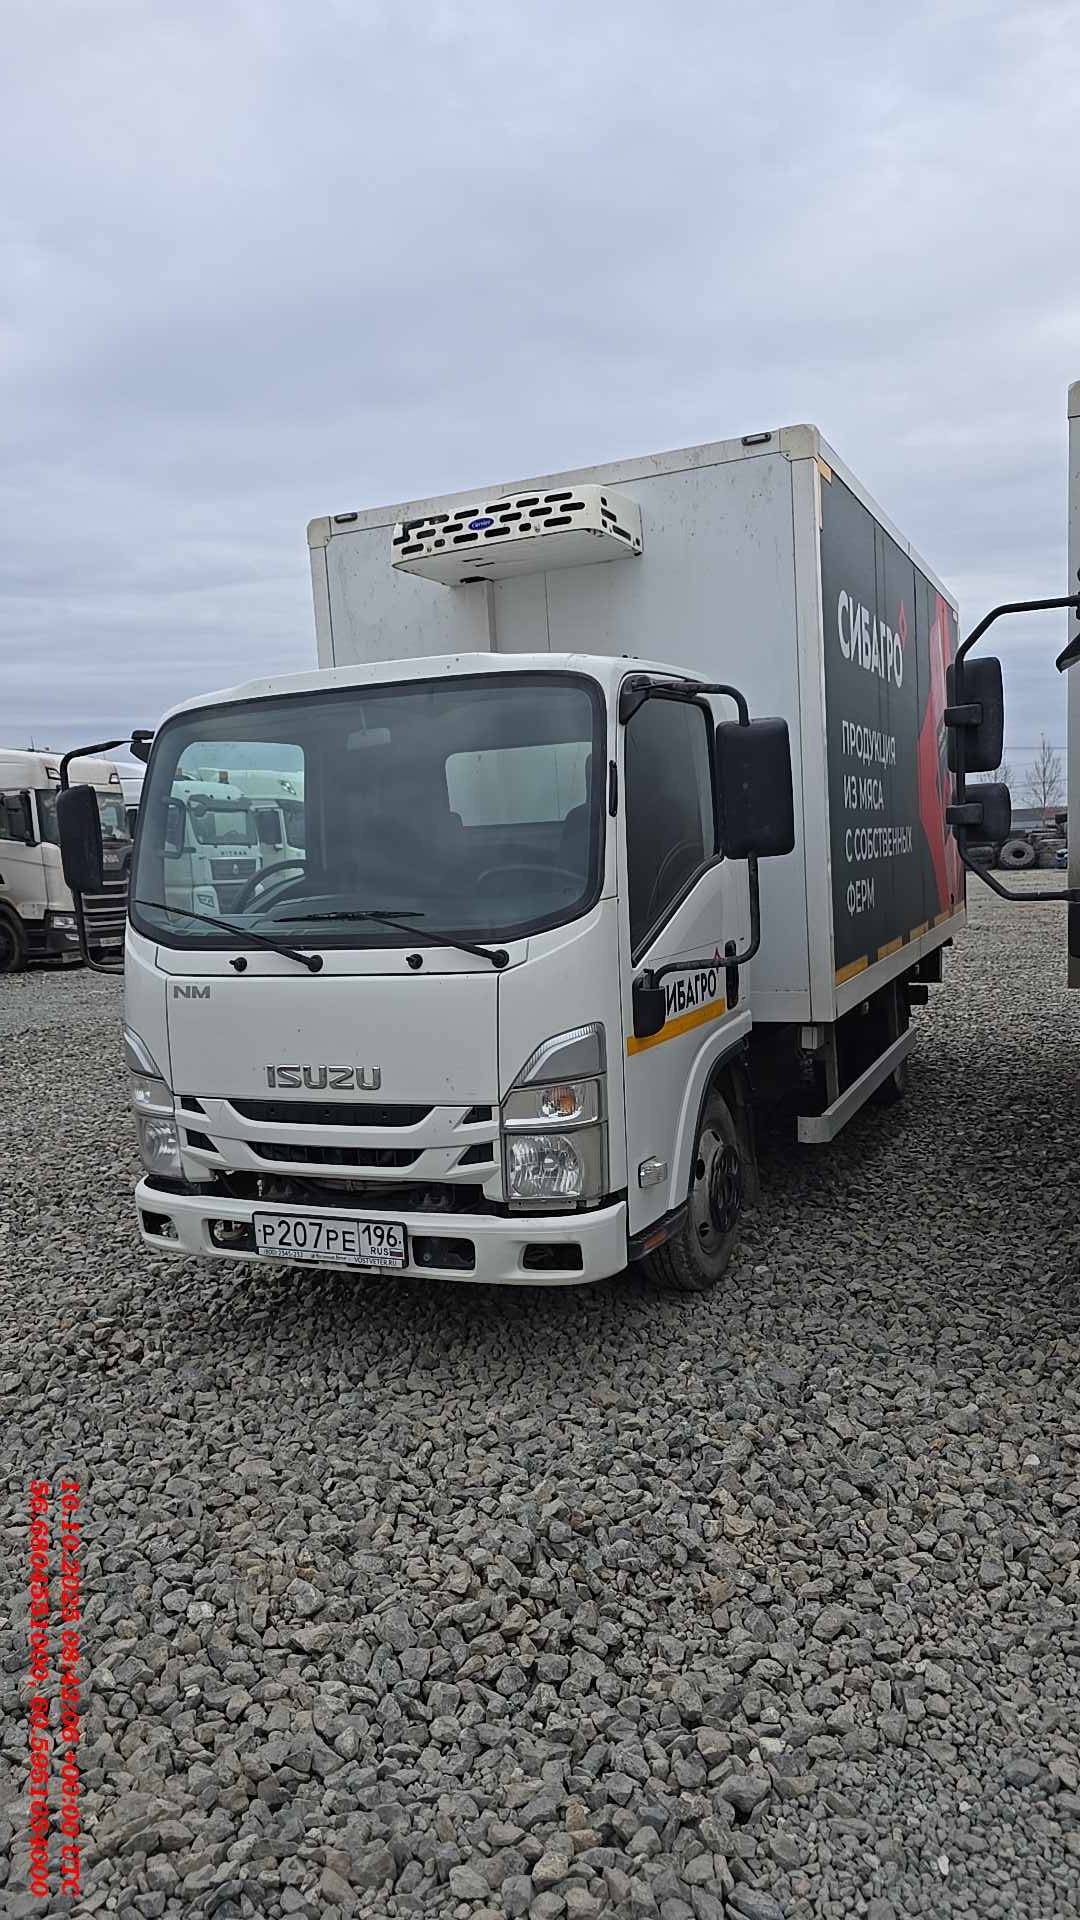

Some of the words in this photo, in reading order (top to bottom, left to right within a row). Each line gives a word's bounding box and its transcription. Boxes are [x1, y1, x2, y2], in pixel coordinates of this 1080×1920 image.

[837, 590, 904, 688] СИБАГРО
[842, 720, 896, 768] ПРОДУКЦИЯ
[843, 774, 858, 811] ИЗ
[859, 776, 885, 811] МЯСА
[845, 827, 853, 862] С
[854, 825, 913, 860] СОБСТВЕННЫХ
[846, 877, 876, 916] ФЕРМ
[173, 986, 211, 999] NM
[666, 969, 717, 1017] ИБАГРО
[266, 1064, 382, 1091] ISUZU
[362, 1225, 397, 1247] 196
[370, 1247, 389, 1256] RUS
